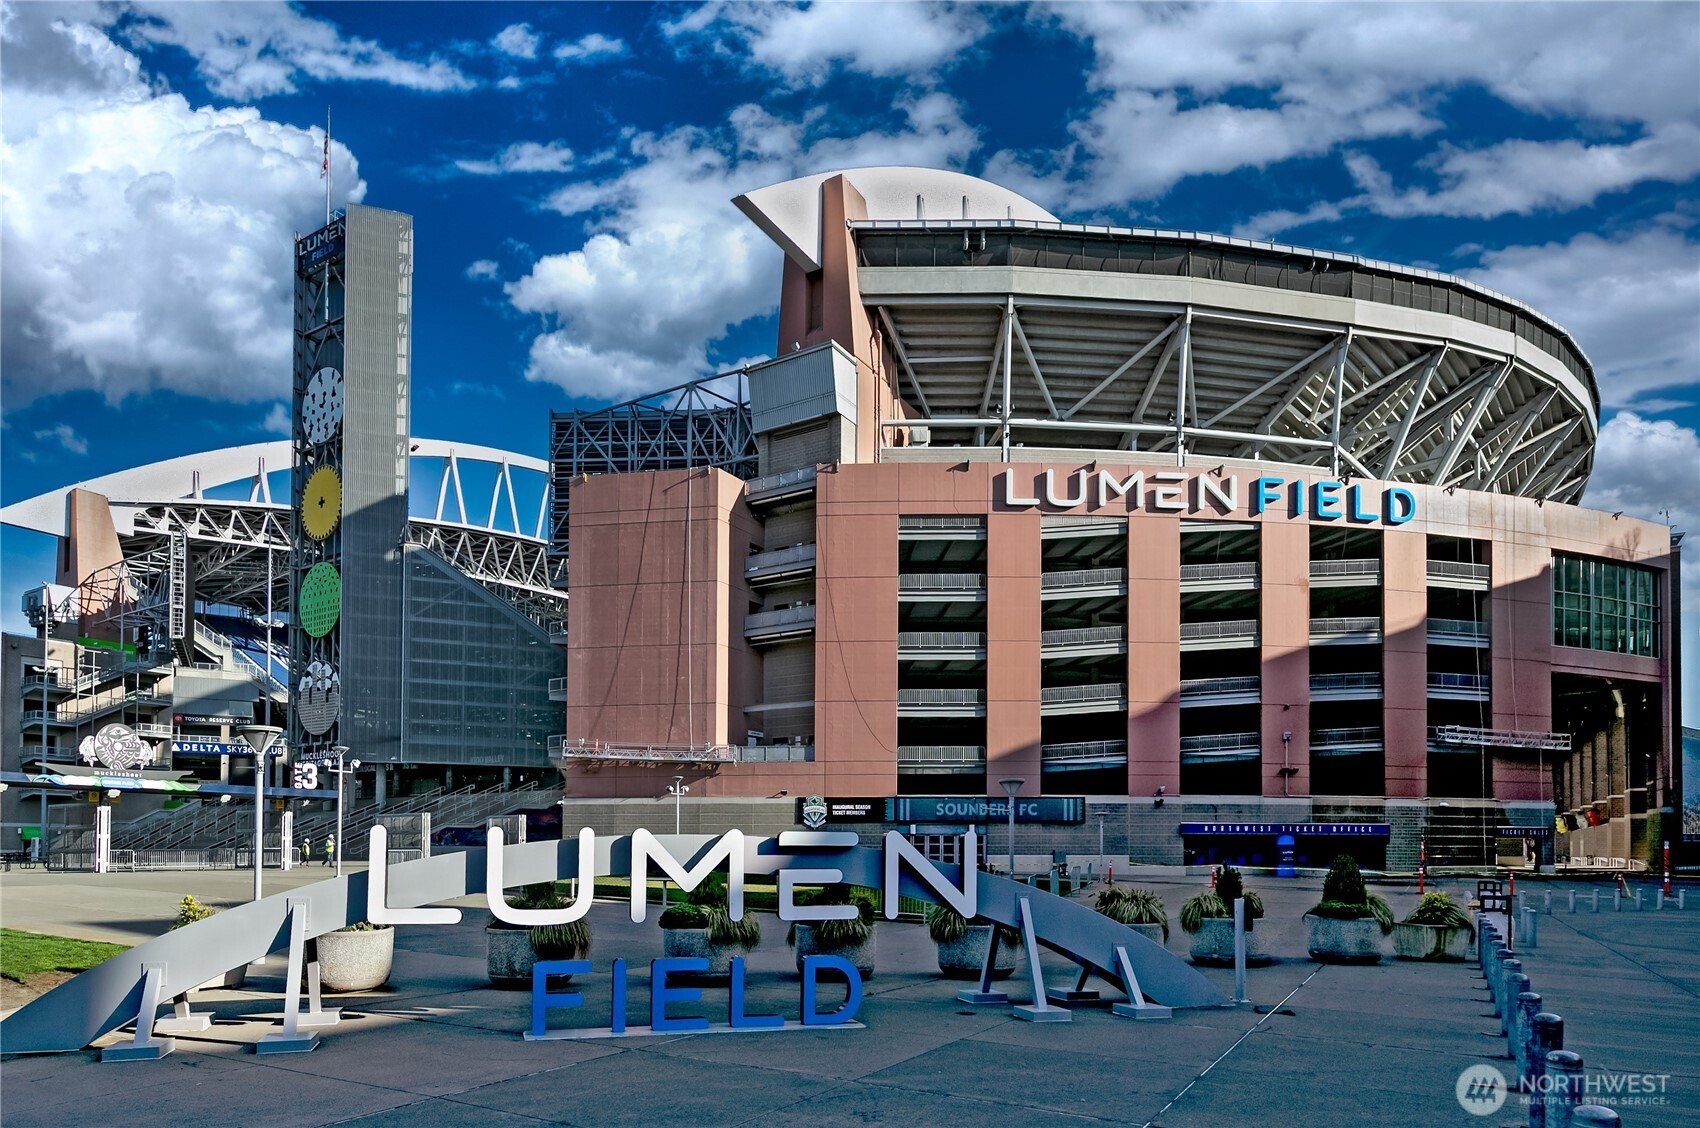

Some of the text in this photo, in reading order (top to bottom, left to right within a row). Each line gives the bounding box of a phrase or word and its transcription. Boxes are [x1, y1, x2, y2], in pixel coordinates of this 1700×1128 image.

[300, 222, 346, 256] LUMEN
[312, 243, 335, 262] FIELD
[1006, 468, 1416, 523] LUMEN FIELD
[183, 743, 220, 752] DELTA
[227, 745, 255, 754] SKY36
[94, 770, 142, 778] muckleshoot
[302, 763, 317, 790] 3
[1019, 803, 1038, 816] FC
[367, 824, 977, 925] LUMEN
[532, 955, 862, 1035] FIELD
